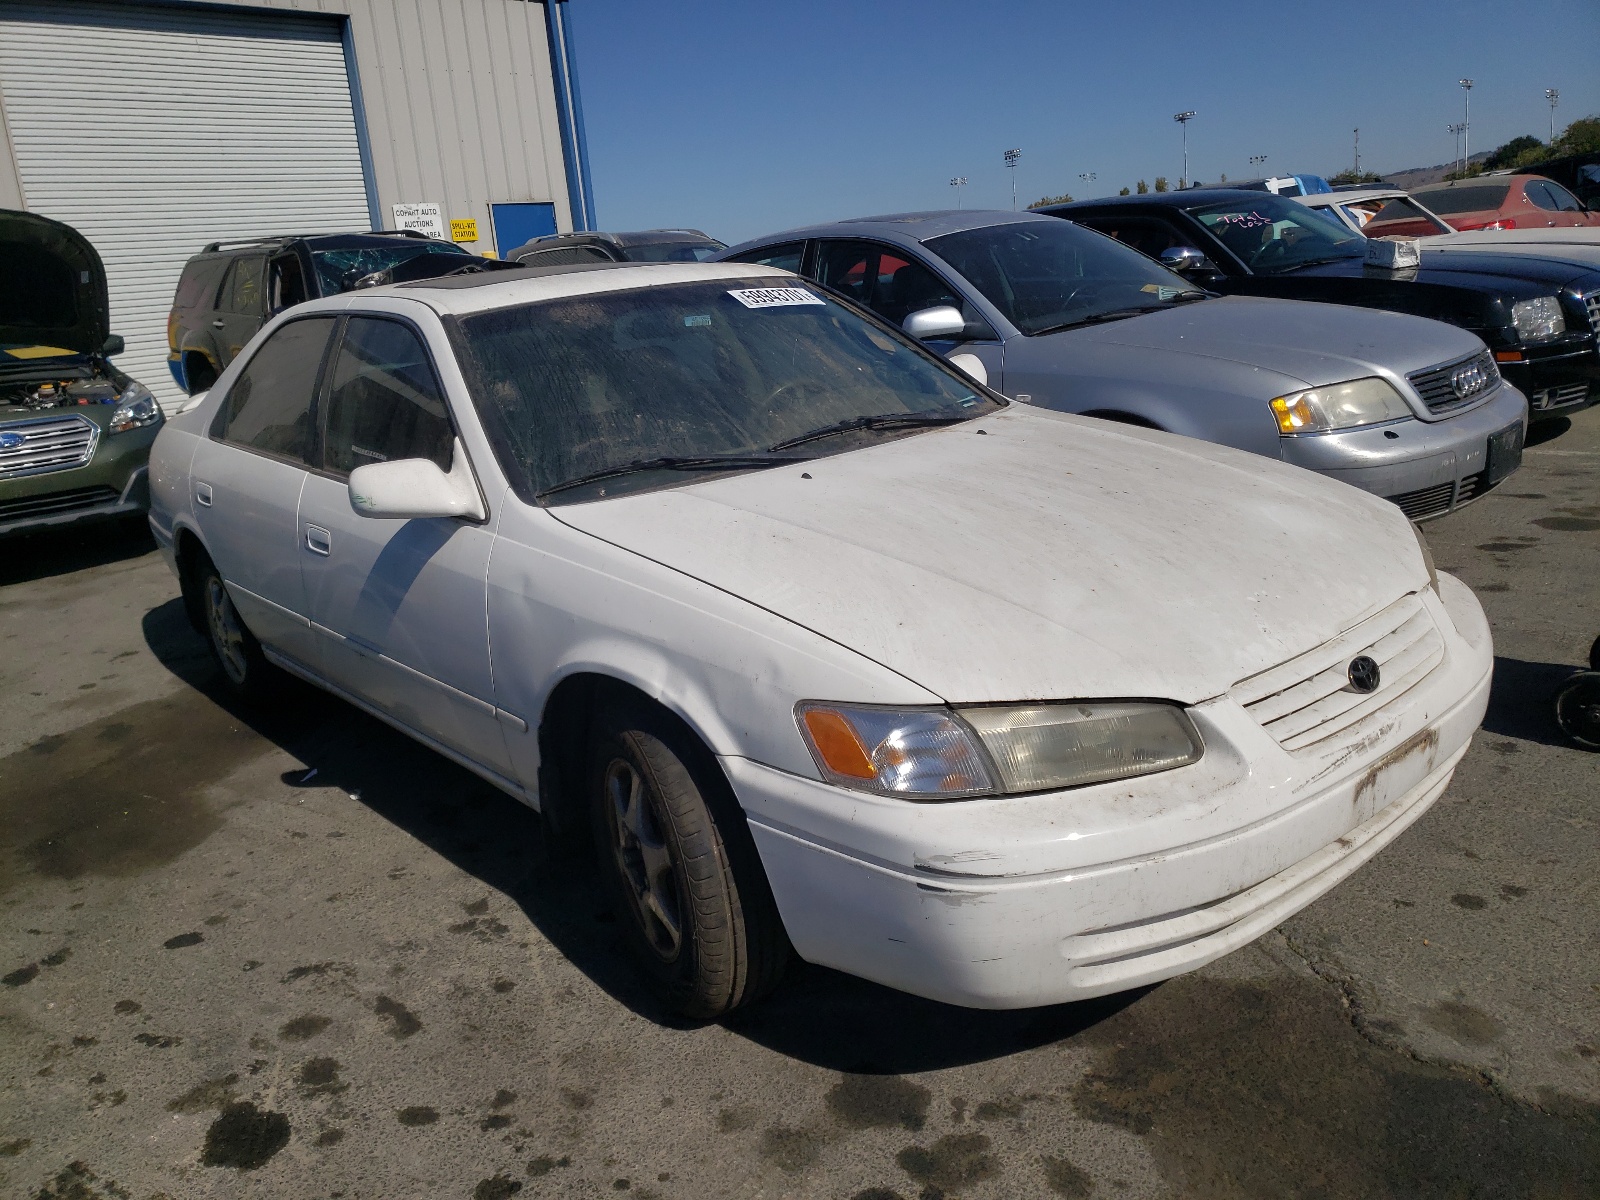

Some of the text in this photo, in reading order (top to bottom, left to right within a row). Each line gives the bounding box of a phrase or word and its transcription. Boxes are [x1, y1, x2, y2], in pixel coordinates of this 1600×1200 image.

[404, 220, 434, 228] AUCTIONS
[451, 222, 476, 230] SPILL-KIT
[454, 230, 476, 238] STATION
[739, 287, 810, 304] 59943701
